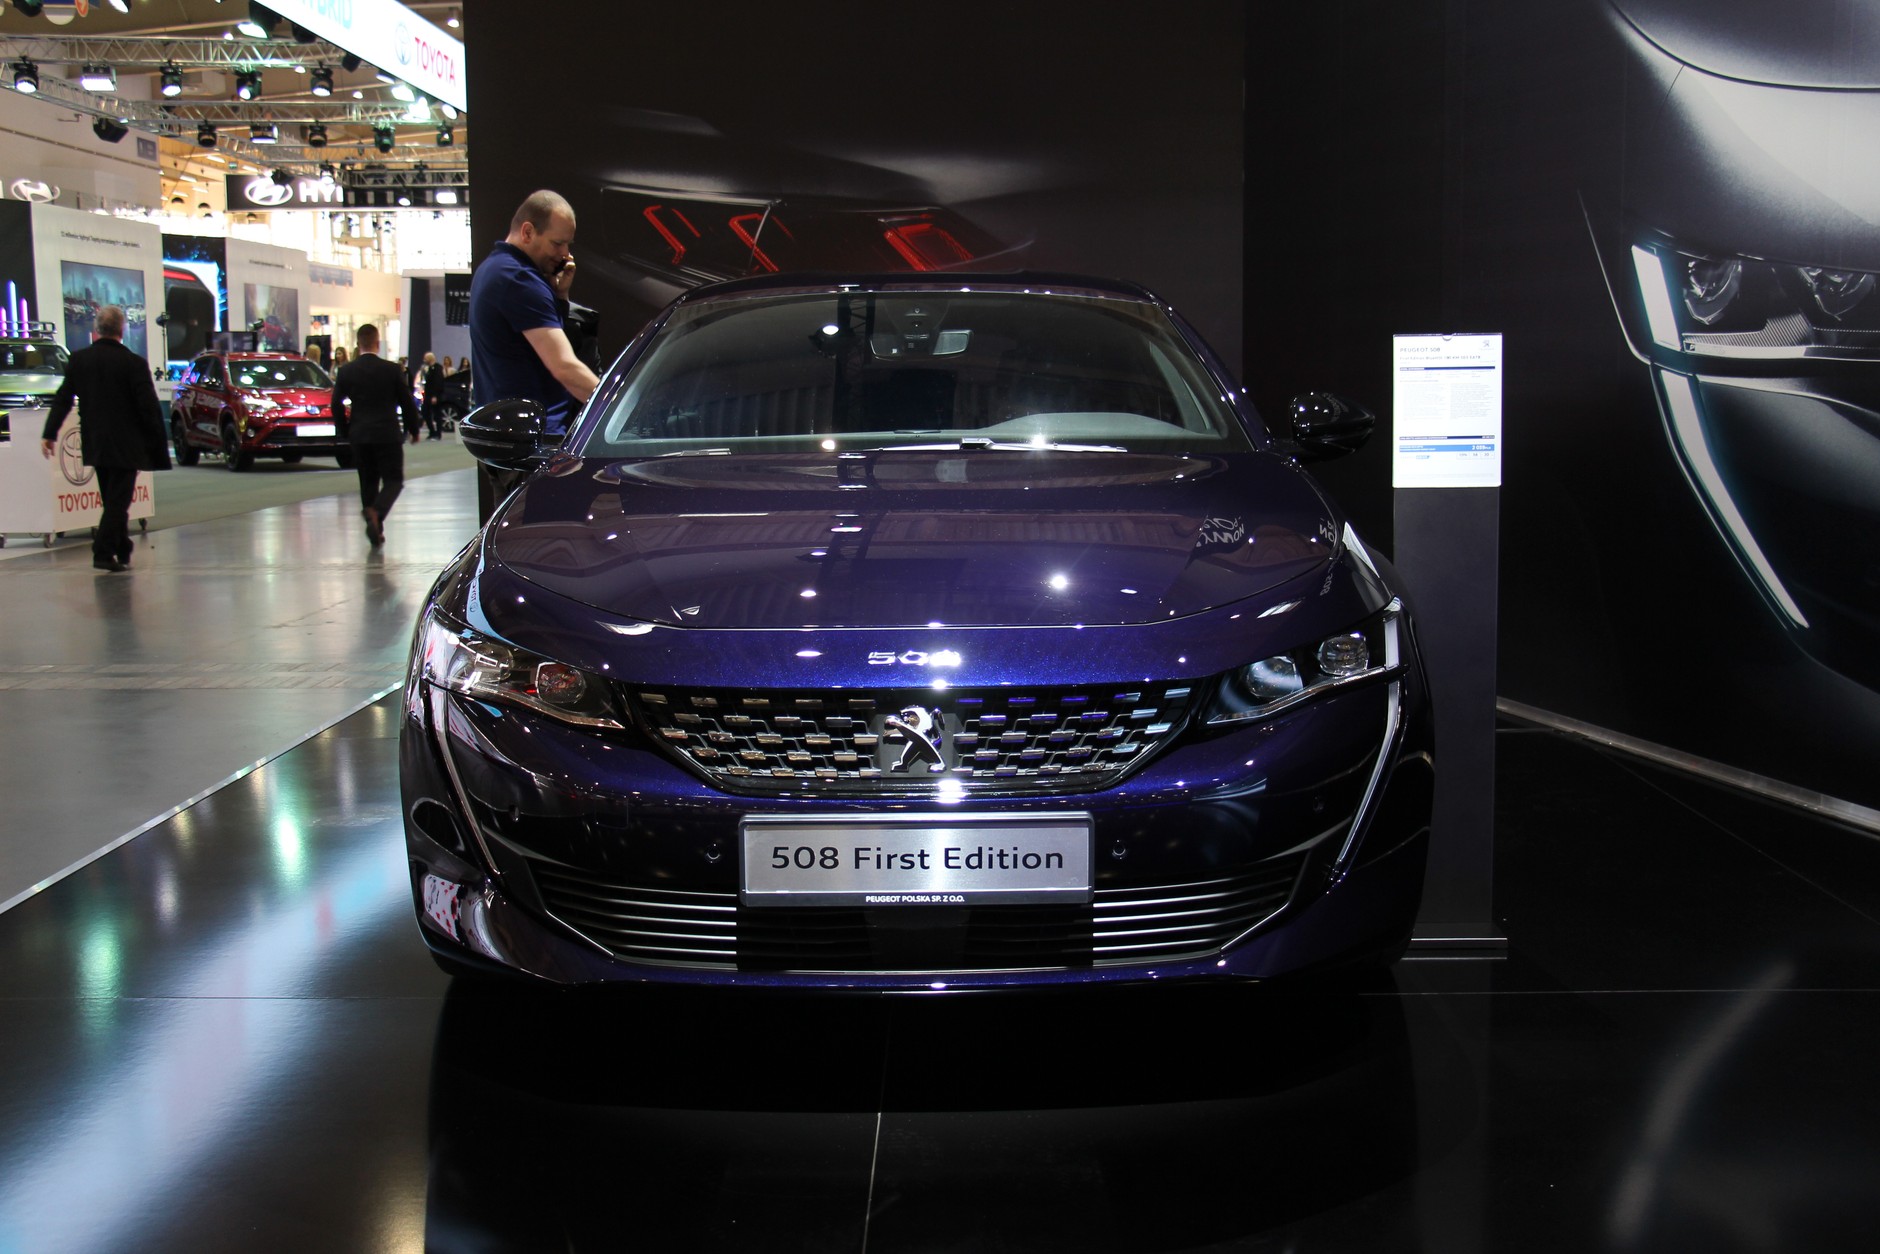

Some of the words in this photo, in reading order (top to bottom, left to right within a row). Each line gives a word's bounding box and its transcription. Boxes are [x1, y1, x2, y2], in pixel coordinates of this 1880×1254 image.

[414, 36, 457, 87] TOYOTA
[58, 491, 103, 513] TOYOTA
[868, 649, 961, 667] 50
[771, 846, 840, 870] 508
[853, 846, 931, 870] First
[943, 846, 1064, 870] Edition
[865, 895, 901, 903] PEUGEOT
